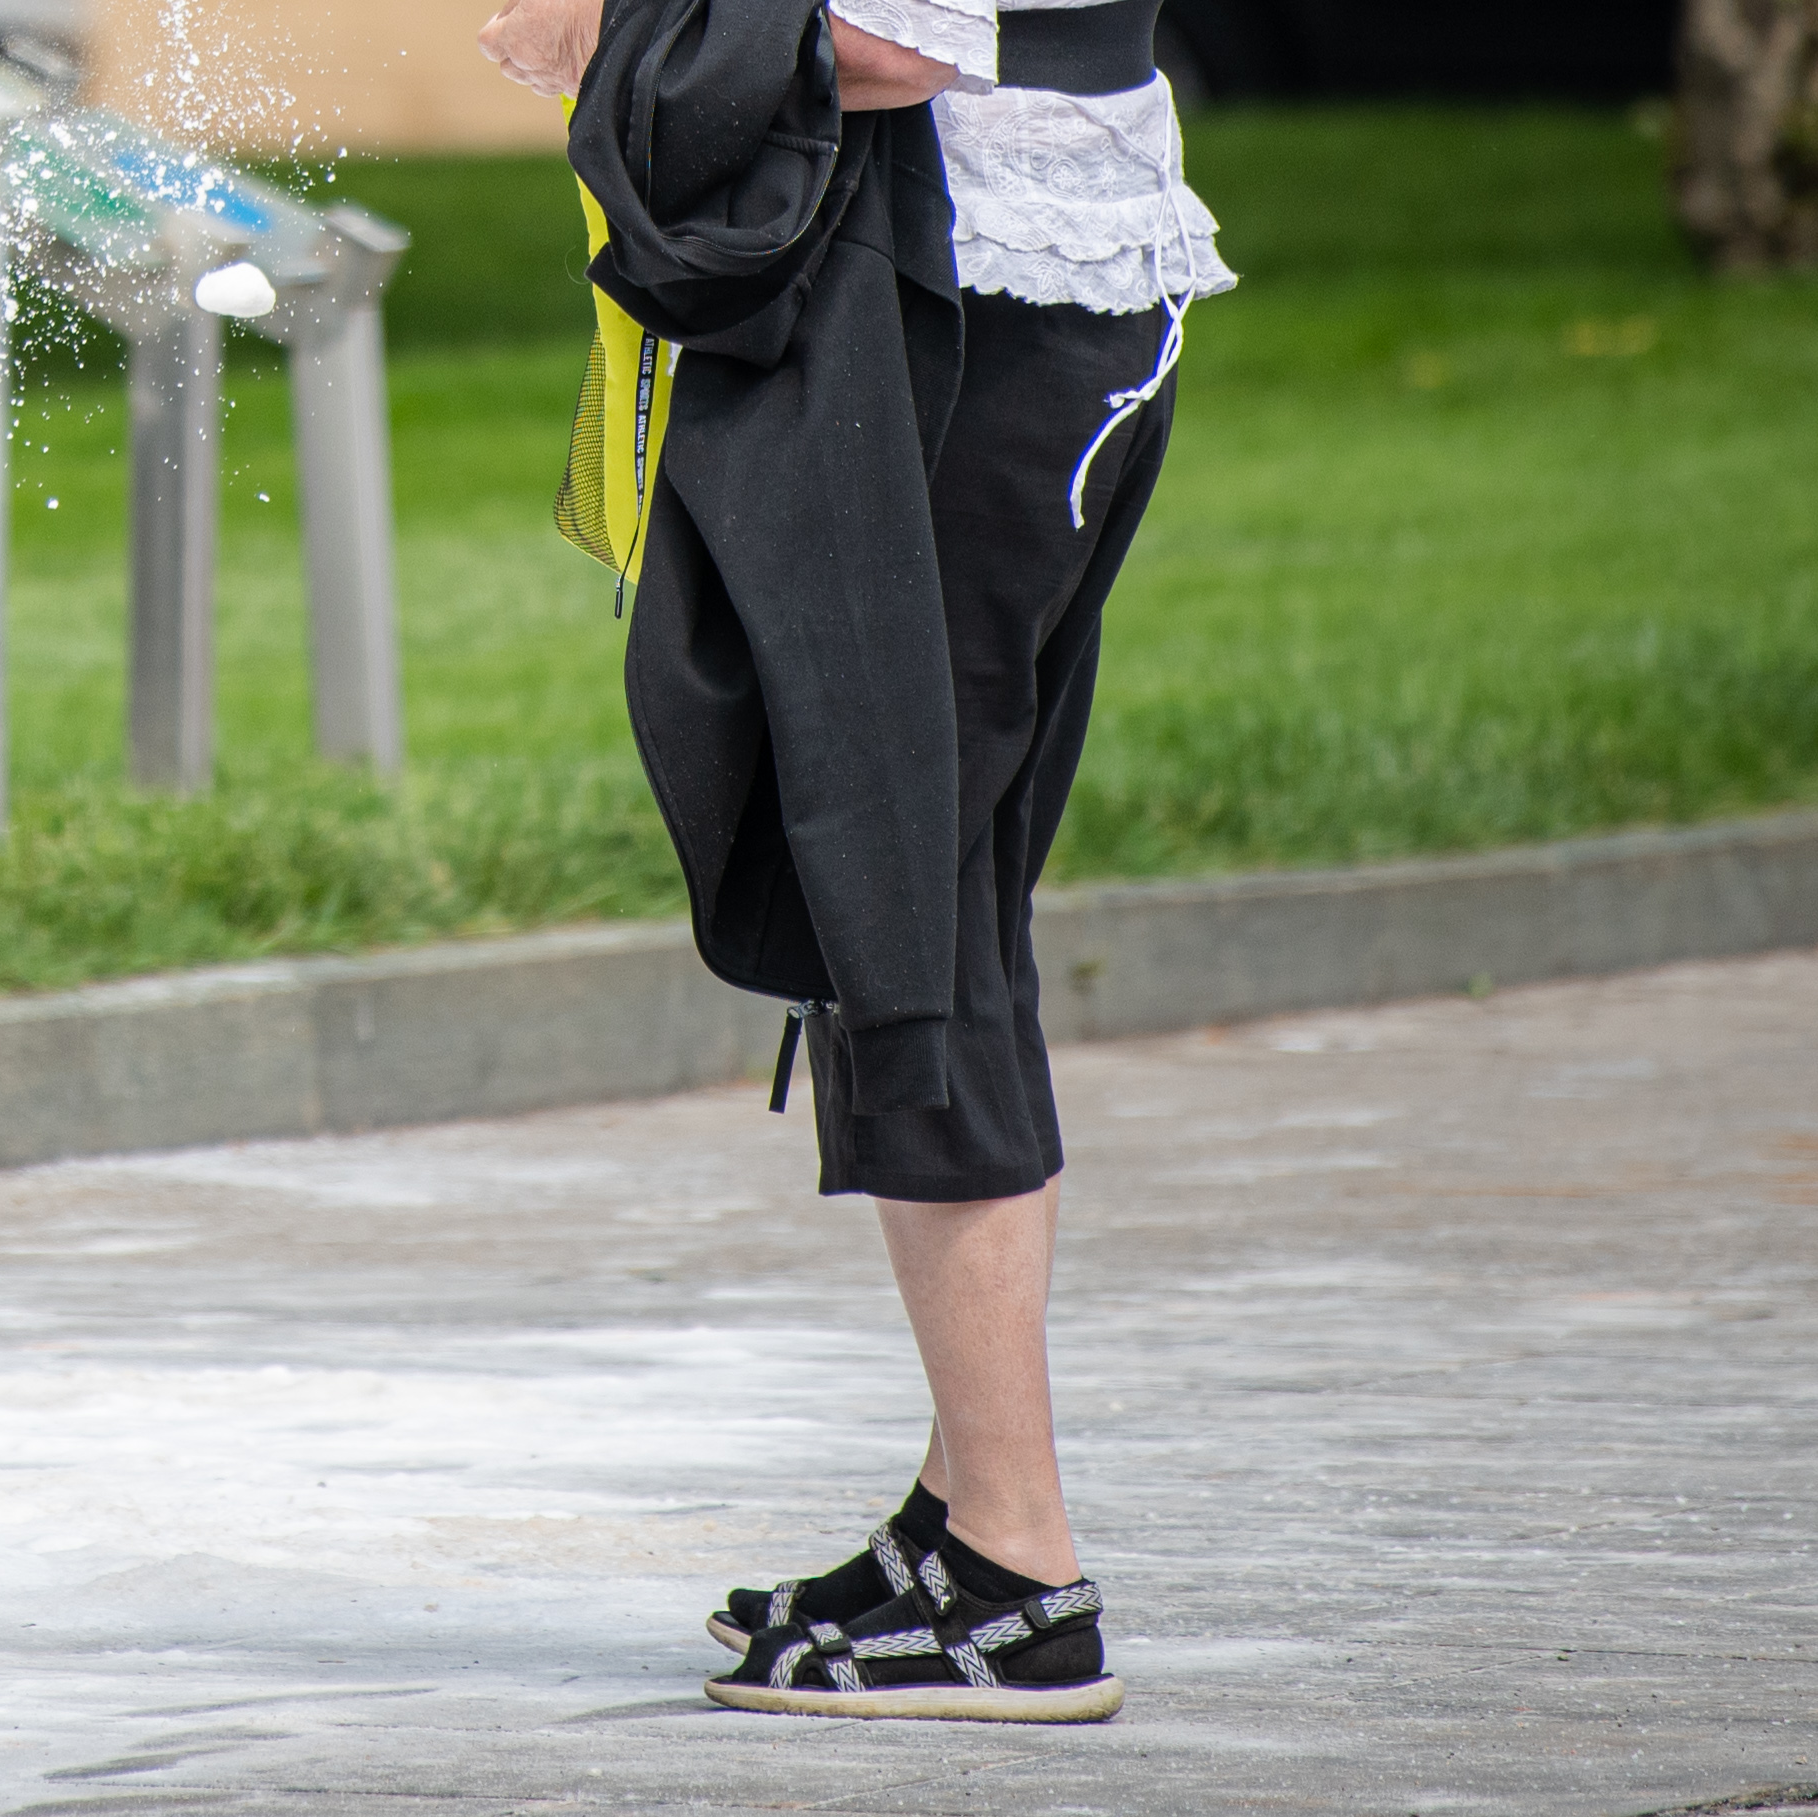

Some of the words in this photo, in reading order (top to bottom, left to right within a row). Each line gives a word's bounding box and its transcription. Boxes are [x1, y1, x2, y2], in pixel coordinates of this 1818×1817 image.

[641, 337, 655, 375] ATHLETIC
[638, 378, 651, 412] SPORTS
[637, 414, 647, 454] ATHLETIC
